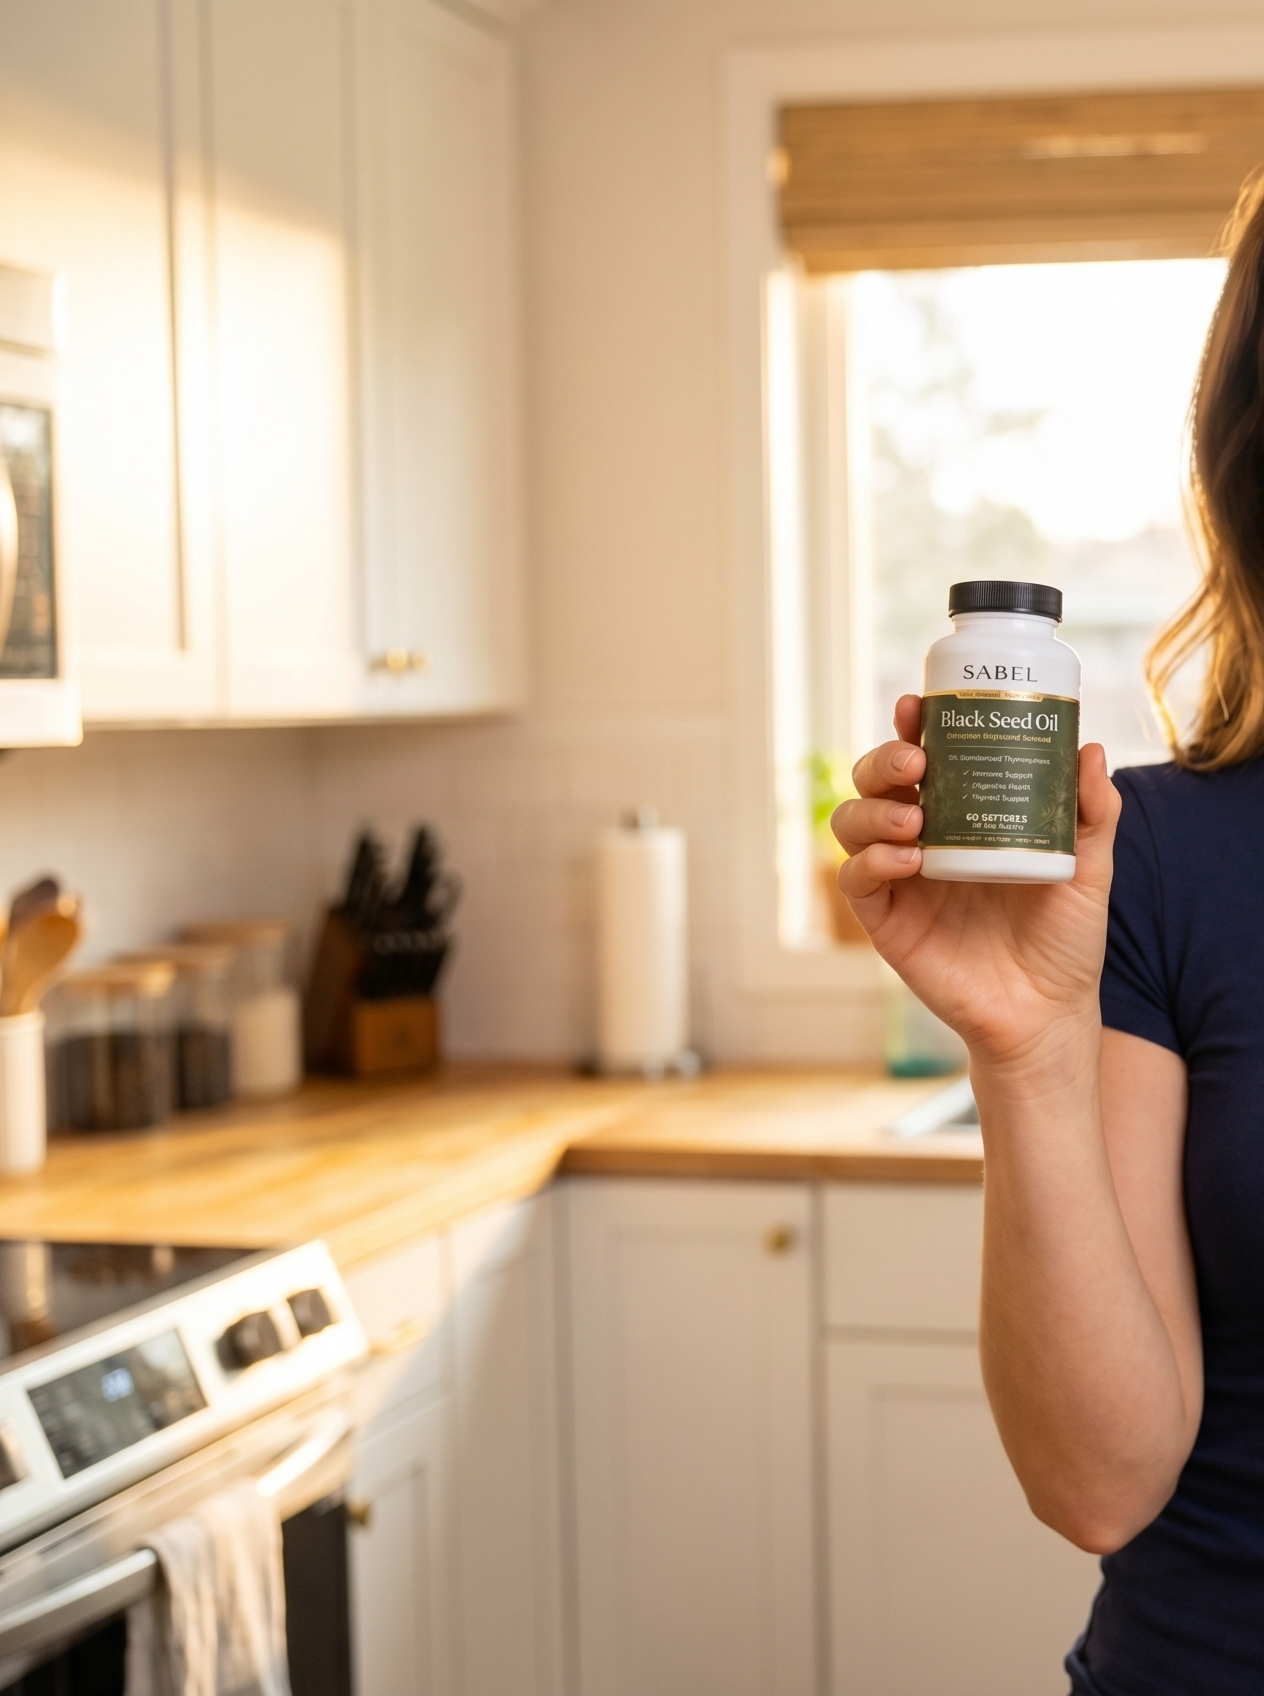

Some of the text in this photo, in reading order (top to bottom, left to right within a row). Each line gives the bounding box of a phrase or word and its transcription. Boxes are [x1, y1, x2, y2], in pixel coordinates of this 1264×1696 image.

[963, 664, 1038, 682] SABEL
[941, 710, 1058, 732] Black Seed Oil
